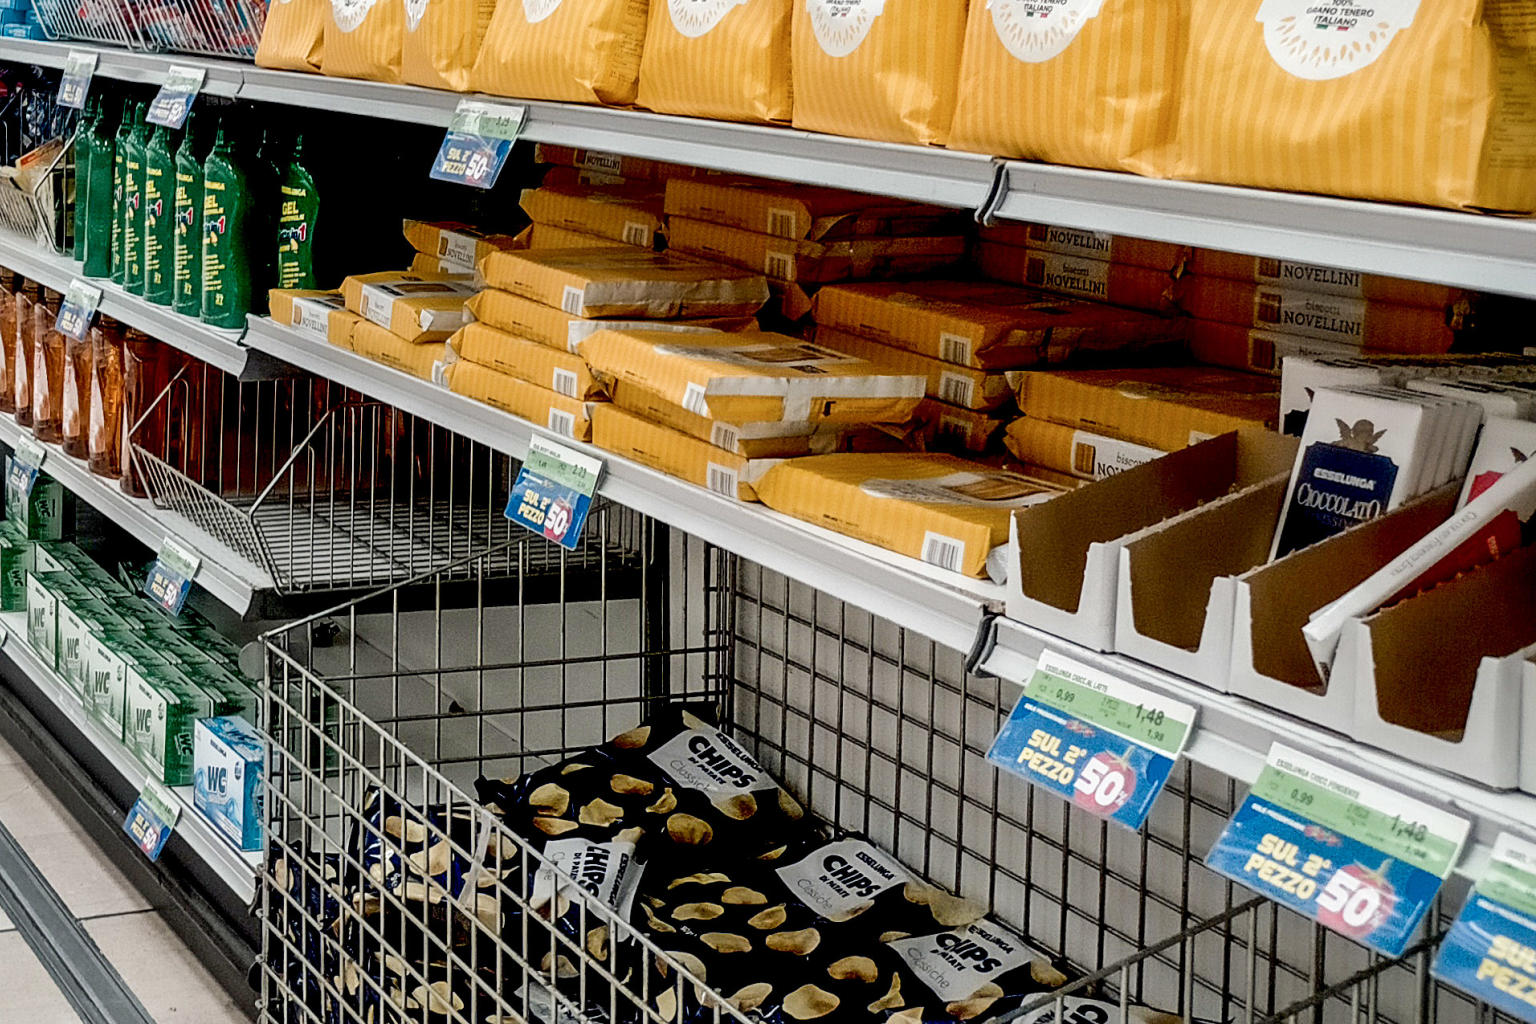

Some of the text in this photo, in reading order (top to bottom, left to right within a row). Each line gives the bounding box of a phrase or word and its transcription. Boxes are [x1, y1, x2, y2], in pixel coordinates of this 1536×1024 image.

[1024, 3, 1054, 14] ITALIANO
[1306, 6, 1375, 17] GRANO TENERO
[1313, 15, 1358, 26] ITALIANO
[282, 201, 300, 215] GEL
[1048, 230, 1109, 252] NOVELLINI
[1046, 272, 1105, 295] NOVELLINI
[1284, 264, 1360, 288] NOVELLINI
[1283, 310, 1361, 336] NOVELLINI
[1313, 467, 1376, 490] ESSELUNGA
[38, 499, 51, 517] WC
[523, 489, 540, 506] SUL
[1296, 482, 1381, 520] CIOCCOLATO
[517, 502, 545, 525] PEZZO
[12, 570, 24, 587] WC
[34, 607, 45, 627] WC
[66, 637, 80, 660] WC
[94, 670, 110, 695] WC
[135, 707, 152, 733] WC
[1135, 703, 1165, 726] 1,48
[178, 732, 193, 756] WC
[715, 732, 766, 774] ESSELUNGA
[1027, 729, 1062, 757] SUL
[688, 735, 756, 789] CHIPS
[1017, 747, 1075, 785] PEZZO
[207, 765, 227, 795] WC
[1390, 814, 1428, 843] 1,48
[1256, 833, 1301, 869] SUL
[822, 854, 881, 899] CHIPS
[855, 851, 896, 881] ESSELUNGA
[1243, 853, 1318, 900] PEZZO
[796, 878, 834, 911] Classiche
[906, 946, 951, 990] Classiche
